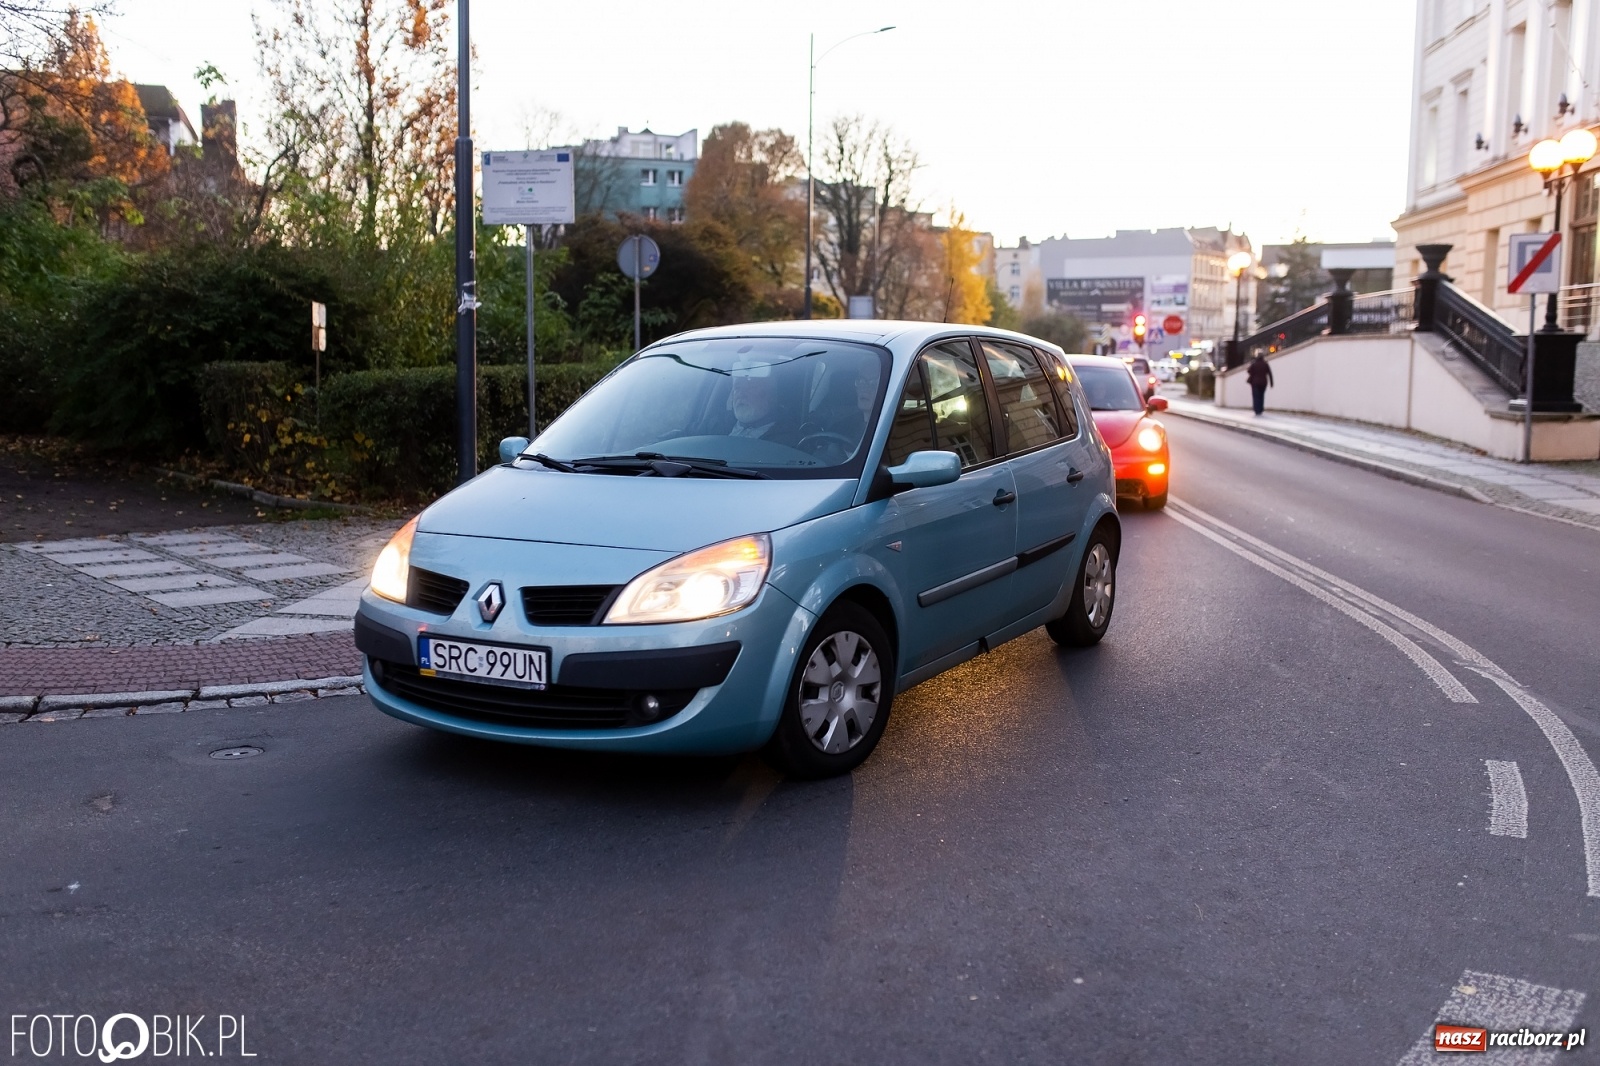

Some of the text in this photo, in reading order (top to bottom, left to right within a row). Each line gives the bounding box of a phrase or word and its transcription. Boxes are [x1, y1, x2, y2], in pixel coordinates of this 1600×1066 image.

[421, 657, 430, 665] PL
[434, 642, 543, 682] SRC 99UN
